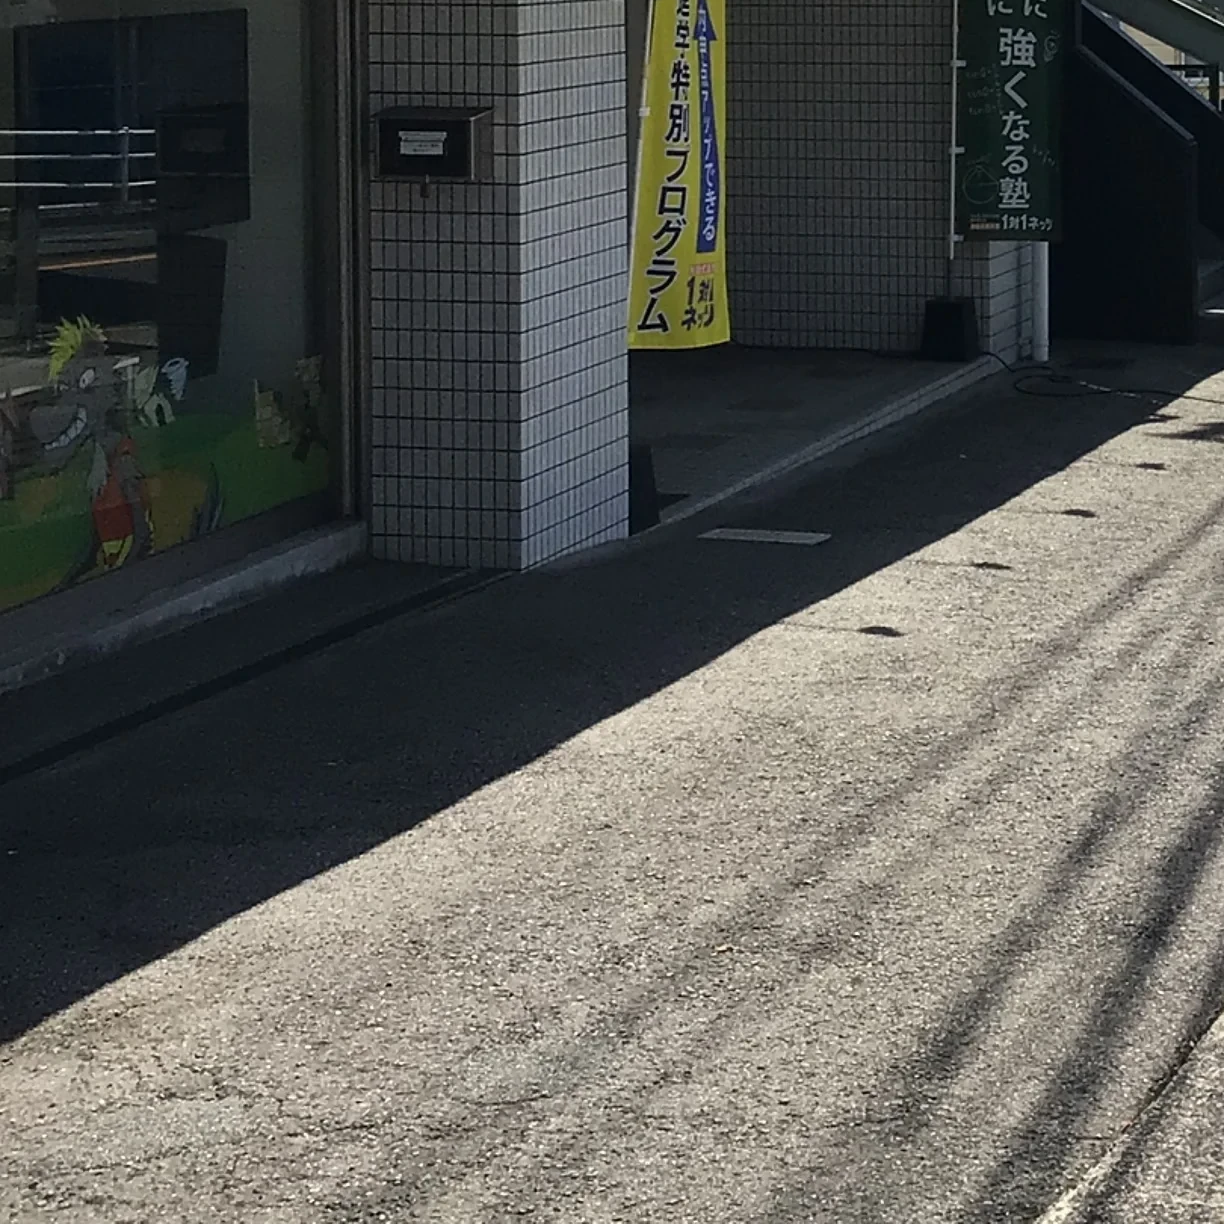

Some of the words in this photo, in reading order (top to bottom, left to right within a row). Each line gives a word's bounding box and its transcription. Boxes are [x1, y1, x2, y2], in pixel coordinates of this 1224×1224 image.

[999, 27, 1038, 209] 強くなる塾
